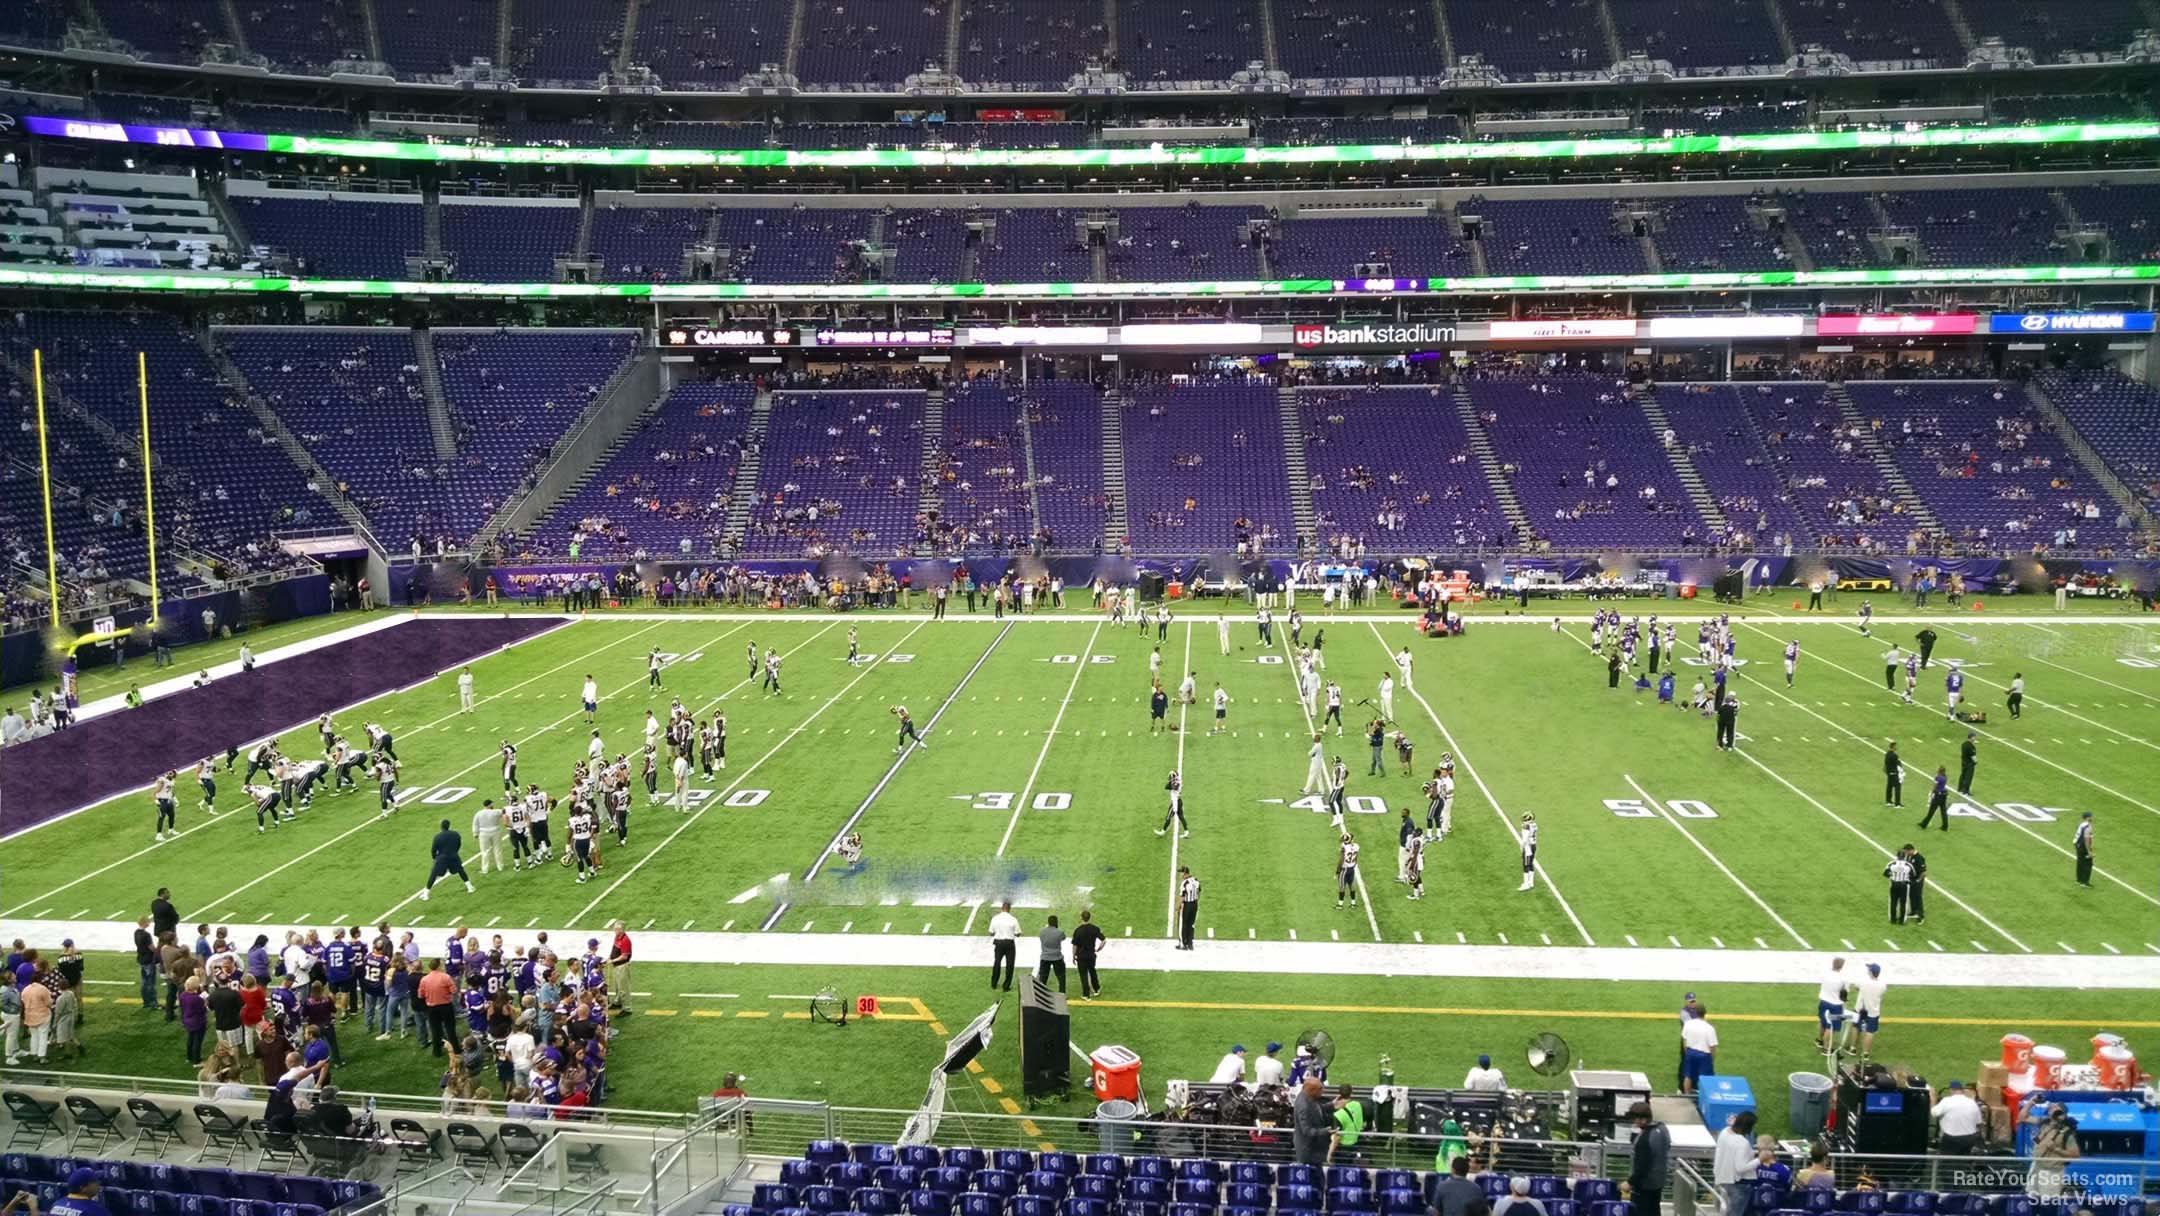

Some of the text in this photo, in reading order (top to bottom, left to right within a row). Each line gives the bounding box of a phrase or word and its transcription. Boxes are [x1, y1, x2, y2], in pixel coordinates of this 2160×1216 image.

[694, 330, 766, 345] CAMBRIA
[532, 799, 544, 811] 71
[971, 792, 1073, 810] 30
[1288, 795, 1389, 813] 40
[1602, 799, 1720, 818] 50
[512, 810, 524, 823] 61
[1946, 802, 2057, 821] 40
[575, 822, 589, 834] 63
[330, 952, 344, 967] 12
[365, 964, 381, 982] 12
[859, 997, 875, 1013] 30
[2017, 1050, 2029, 1061] G
[2050, 1065, 2061, 1076] G
[2115, 1064, 2127, 1076] G
[1095, 1069, 1108, 1092] G
